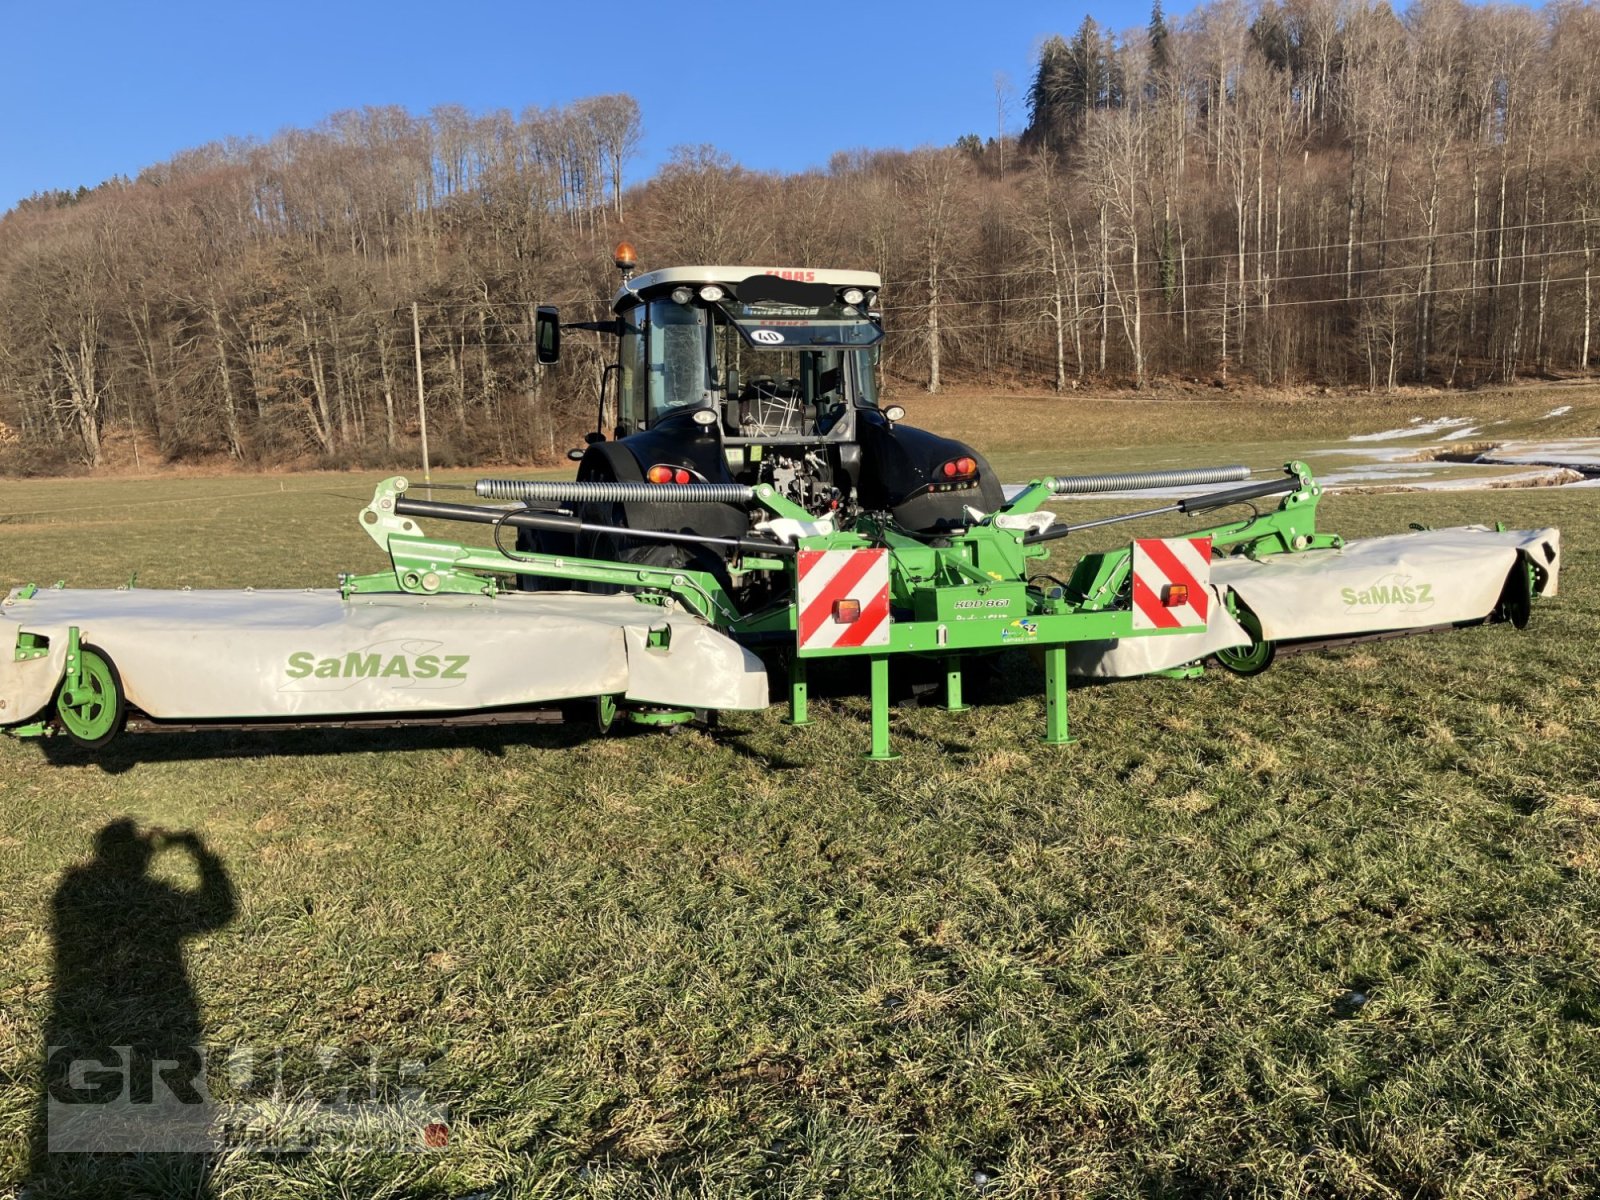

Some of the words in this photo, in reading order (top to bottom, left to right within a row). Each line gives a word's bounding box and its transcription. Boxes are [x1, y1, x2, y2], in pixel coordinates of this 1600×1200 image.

[758, 332, 779, 342] 40
[1341, 584, 1434, 605] SaMASZ
[986, 598, 1010, 608] 861
[286, 652, 470, 679] SaMASZ
